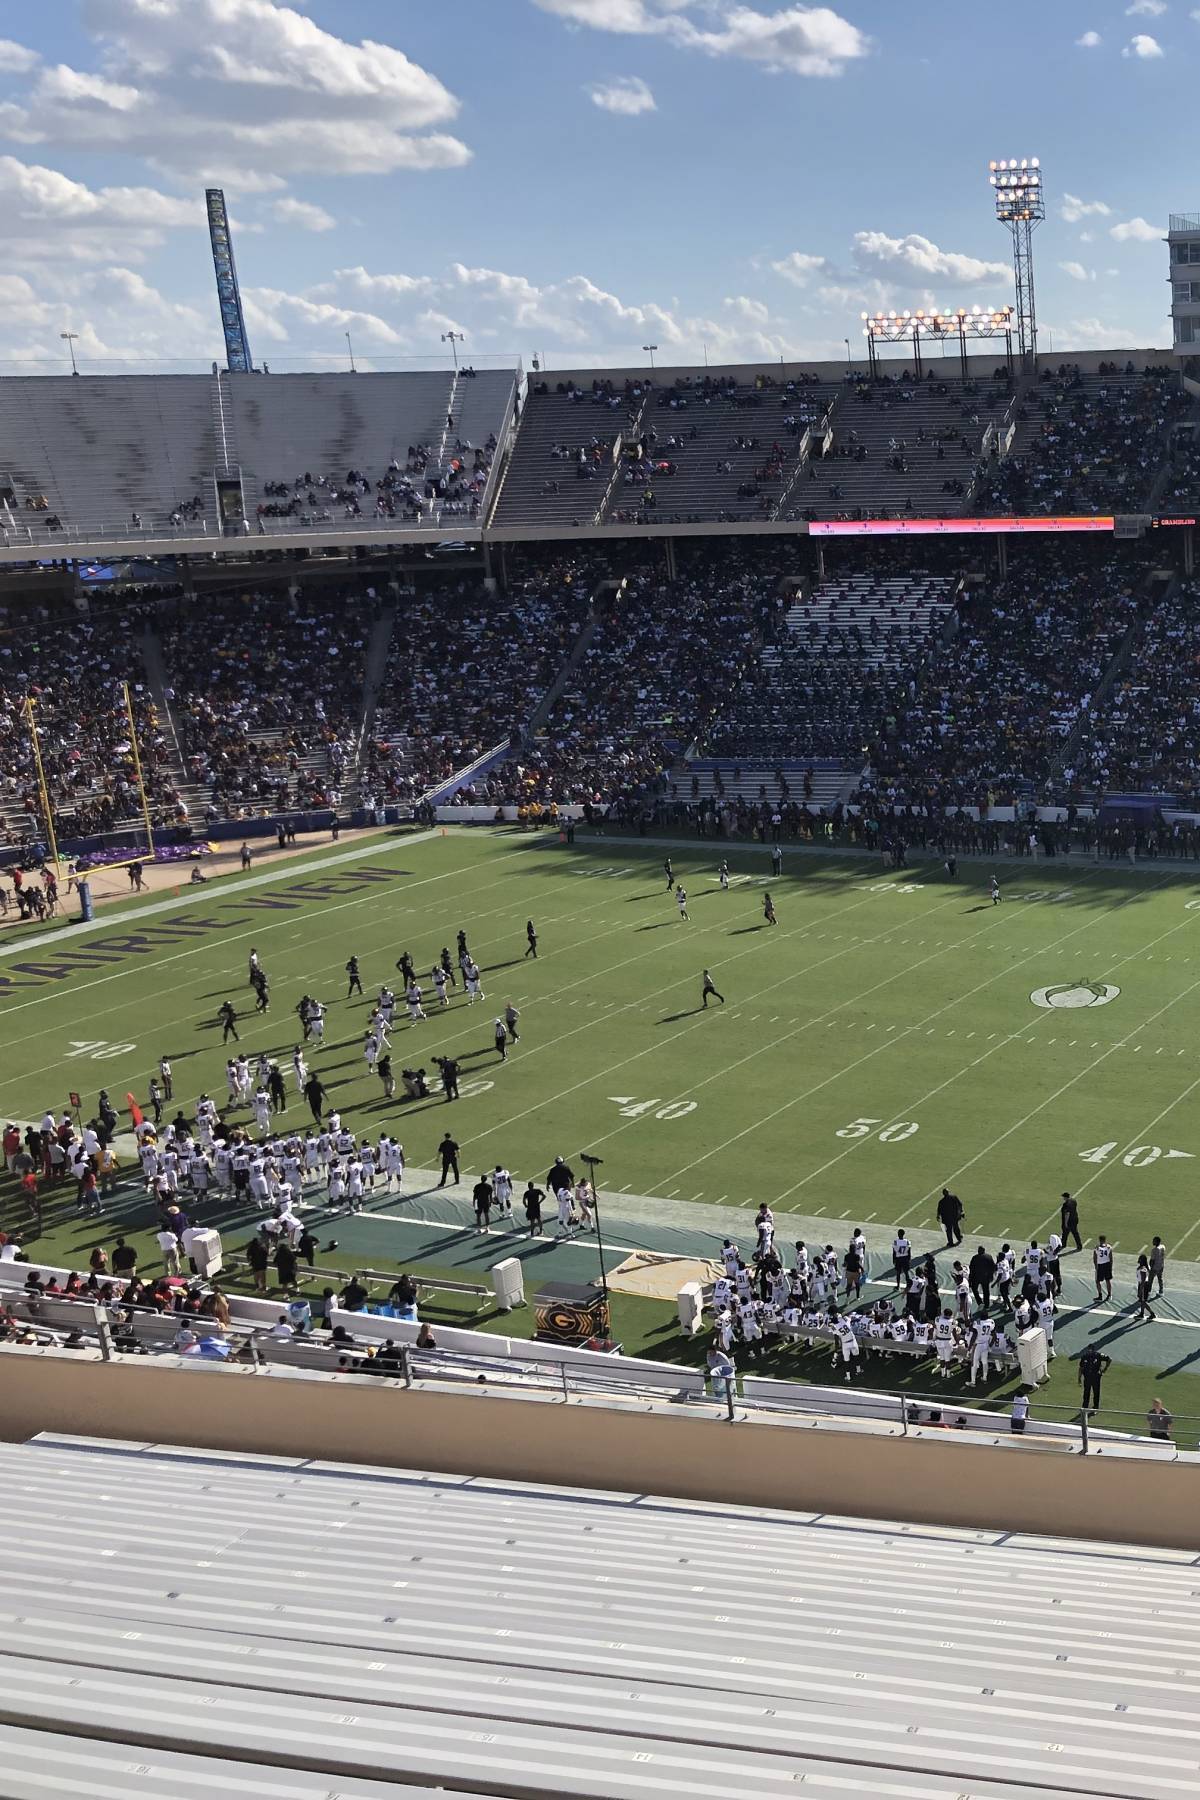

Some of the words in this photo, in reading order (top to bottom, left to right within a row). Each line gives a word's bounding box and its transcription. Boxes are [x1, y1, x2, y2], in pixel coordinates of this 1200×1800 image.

[217, 866, 416, 910] VIEW
[63, 1041, 137, 1059] 10
[618, 1098, 698, 1120] 40
[835, 1118, 919, 1142] 50
[1078, 1141, 1162, 1167] 40
[1099, 1249, 1108, 1258] 34
[1042, 1306, 1052, 1317] 93
[808, 1319, 818, 1328] 25
[940, 1324, 949, 1334] 99
[838, 1324, 850, 1336] 58
[895, 1325, 906, 1336] 59
[916, 1326, 926, 1337] 98
[981, 1325, 991, 1336] 97
